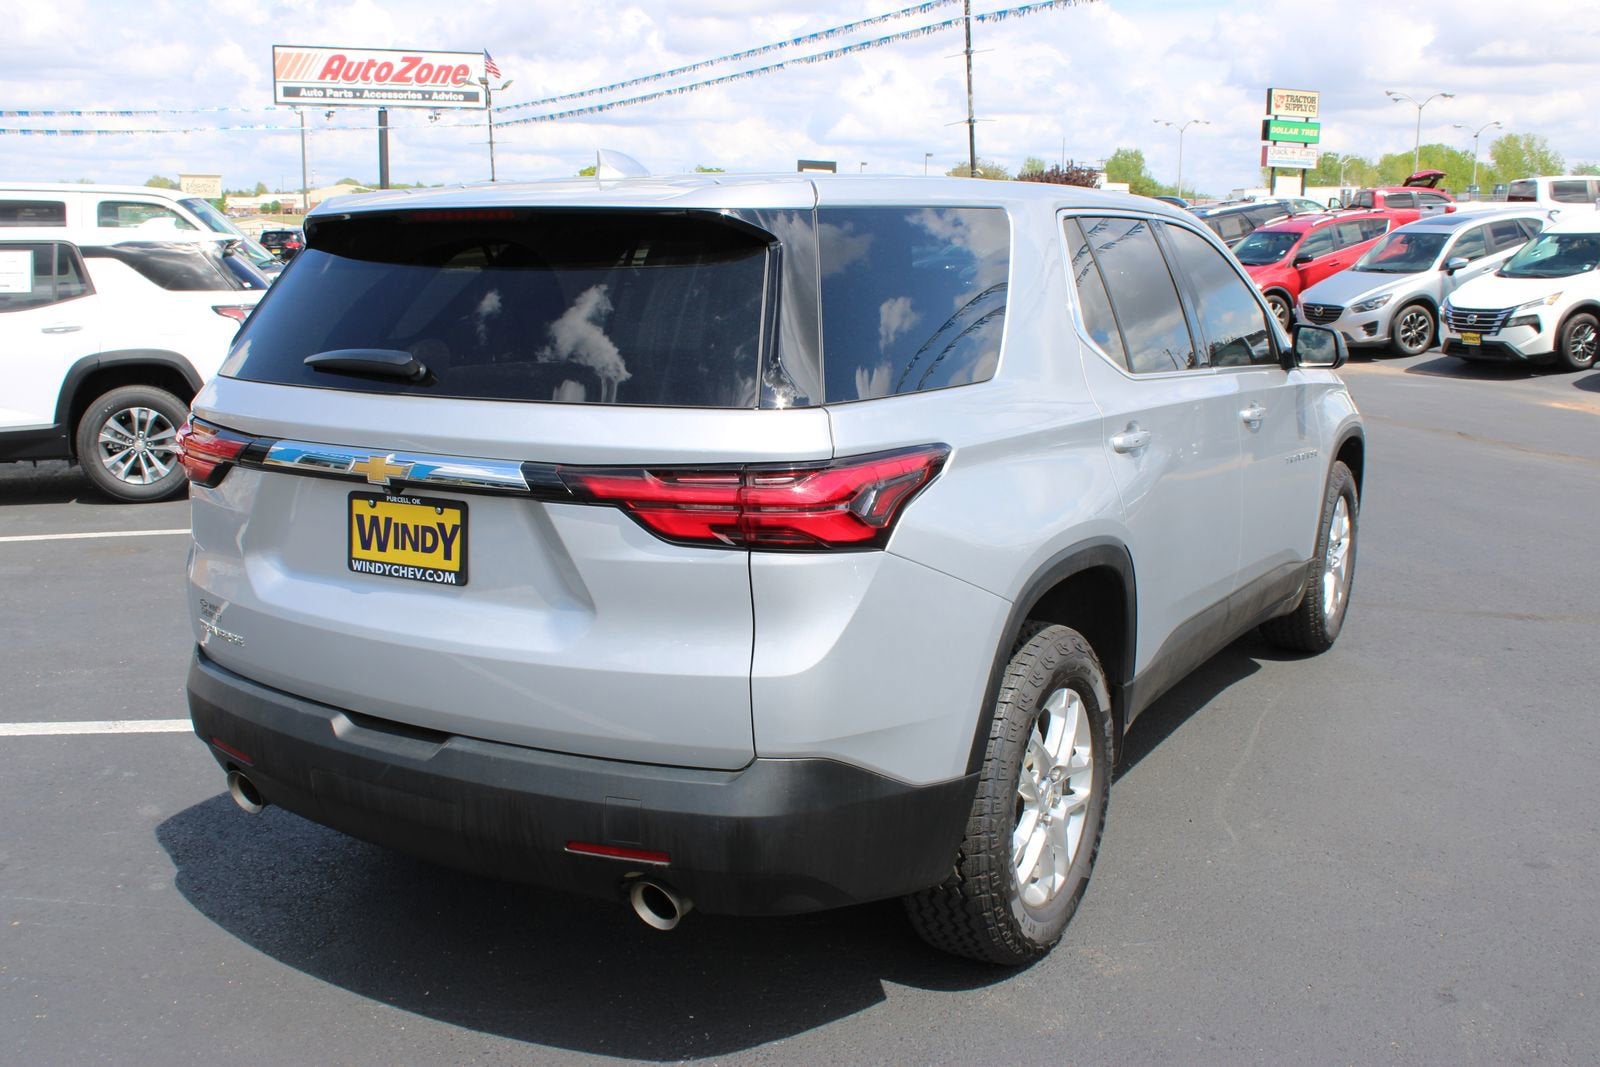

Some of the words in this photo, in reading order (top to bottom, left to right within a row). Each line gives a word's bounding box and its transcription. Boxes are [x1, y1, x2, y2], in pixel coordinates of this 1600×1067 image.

[318, 54, 470, 85] AutoZone
[300, 88, 324, 98] Auto
[326, 89, 353, 99] Parts
[363, 90, 422, 101] Accessories
[431, 91, 464, 101] Advice
[1285, 94, 1317, 104] TRACTOR
[1285, 103, 1308, 112] SUPPLY
[1271, 126, 1299, 136] DOLLAR
[1301, 128, 1319, 137] TREE
[355, 513, 460, 561] WINDY
[351, 559, 456, 584] WINDYCHEV.COM
